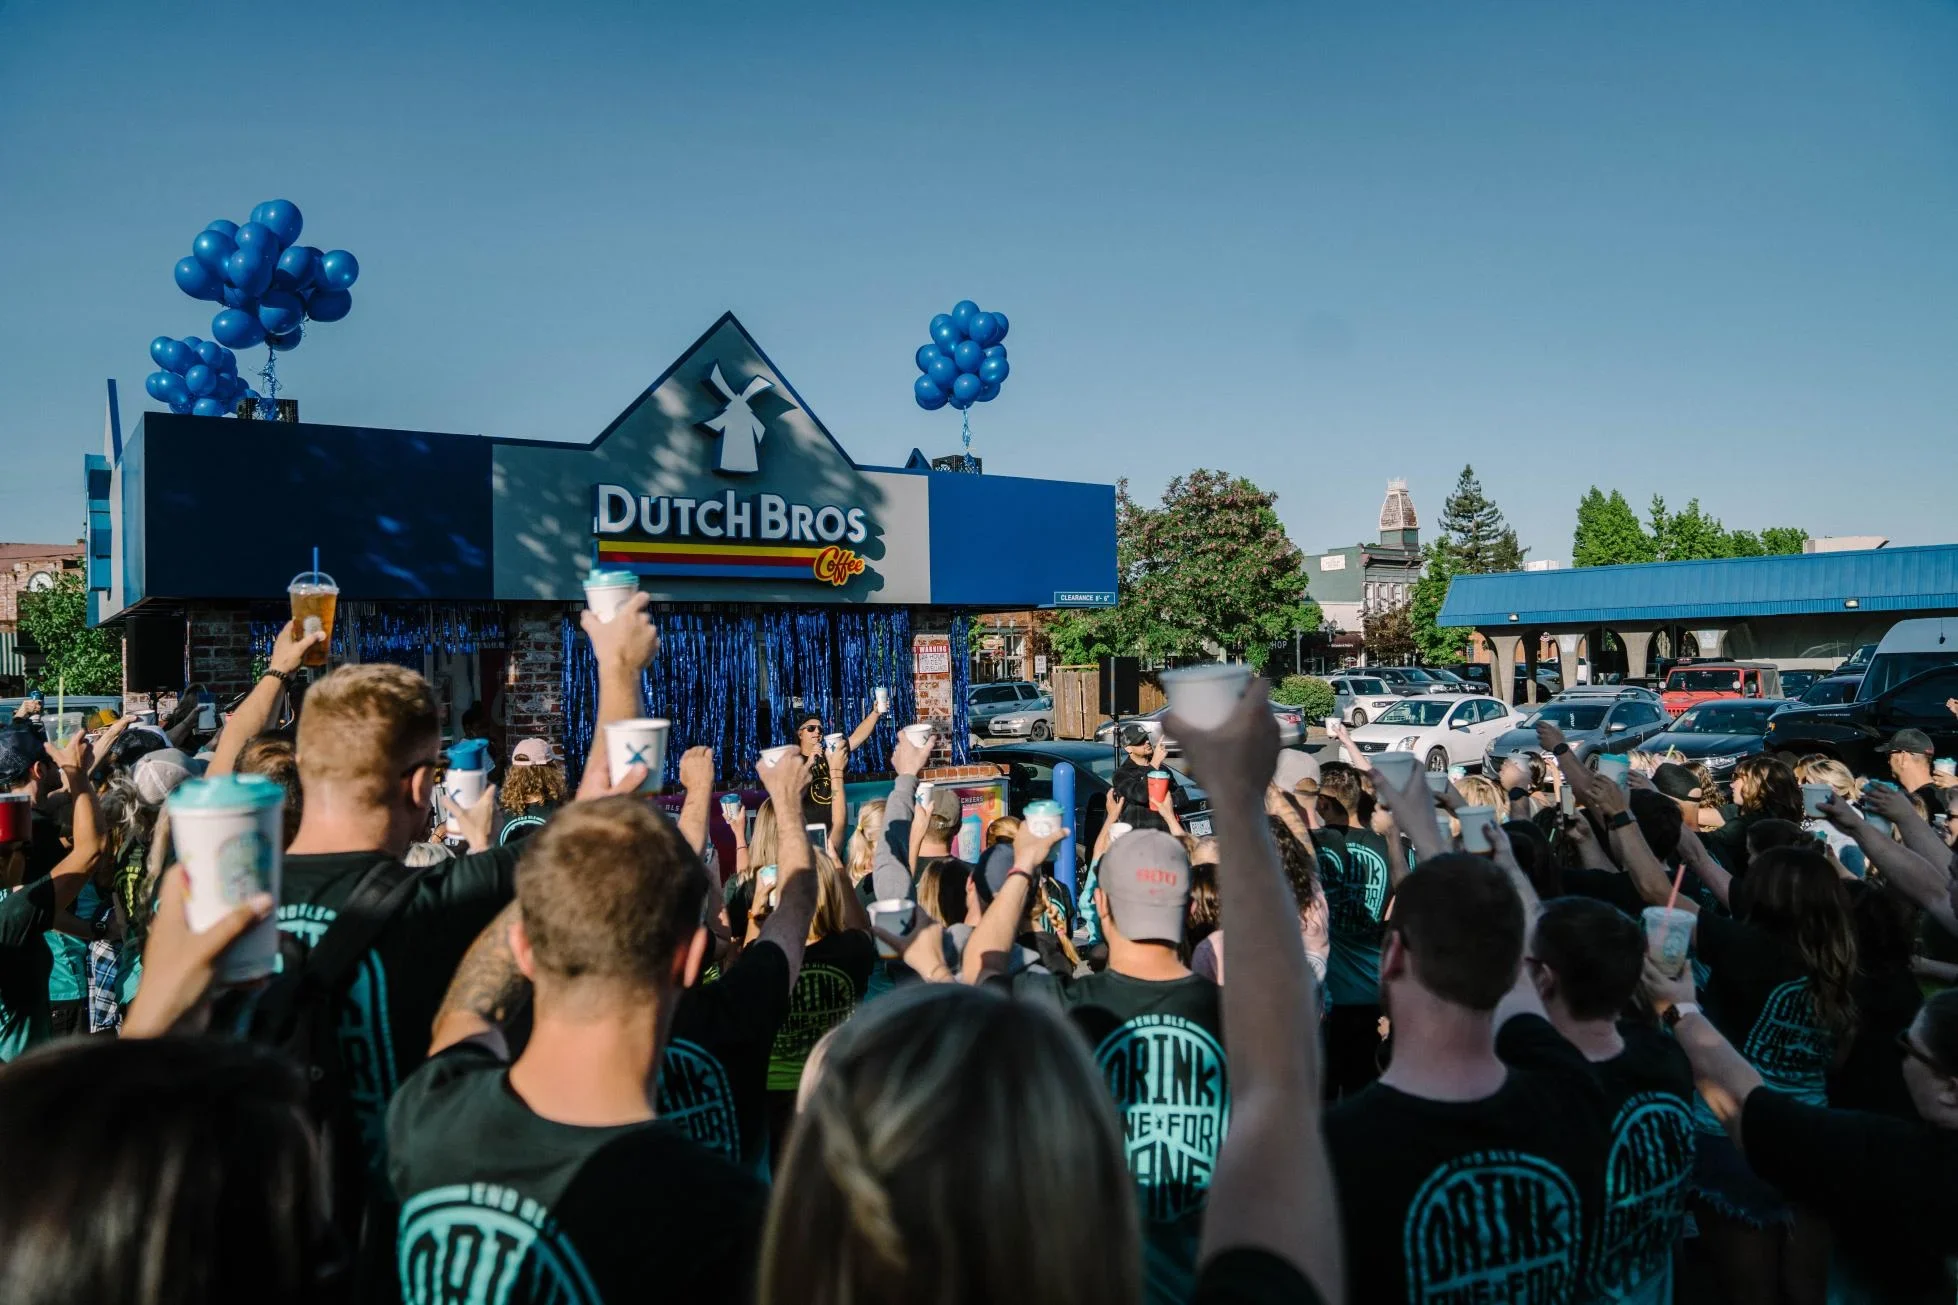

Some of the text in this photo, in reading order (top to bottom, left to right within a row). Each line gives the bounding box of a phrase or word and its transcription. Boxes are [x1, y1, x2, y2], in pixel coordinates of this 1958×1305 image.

[813, 546, 866, 584] Coffee
[919, 645, 947, 653] WARNING
[1106, 1034, 1216, 1107] DRINK
[1120, 1110, 1214, 1157] NE FOR
